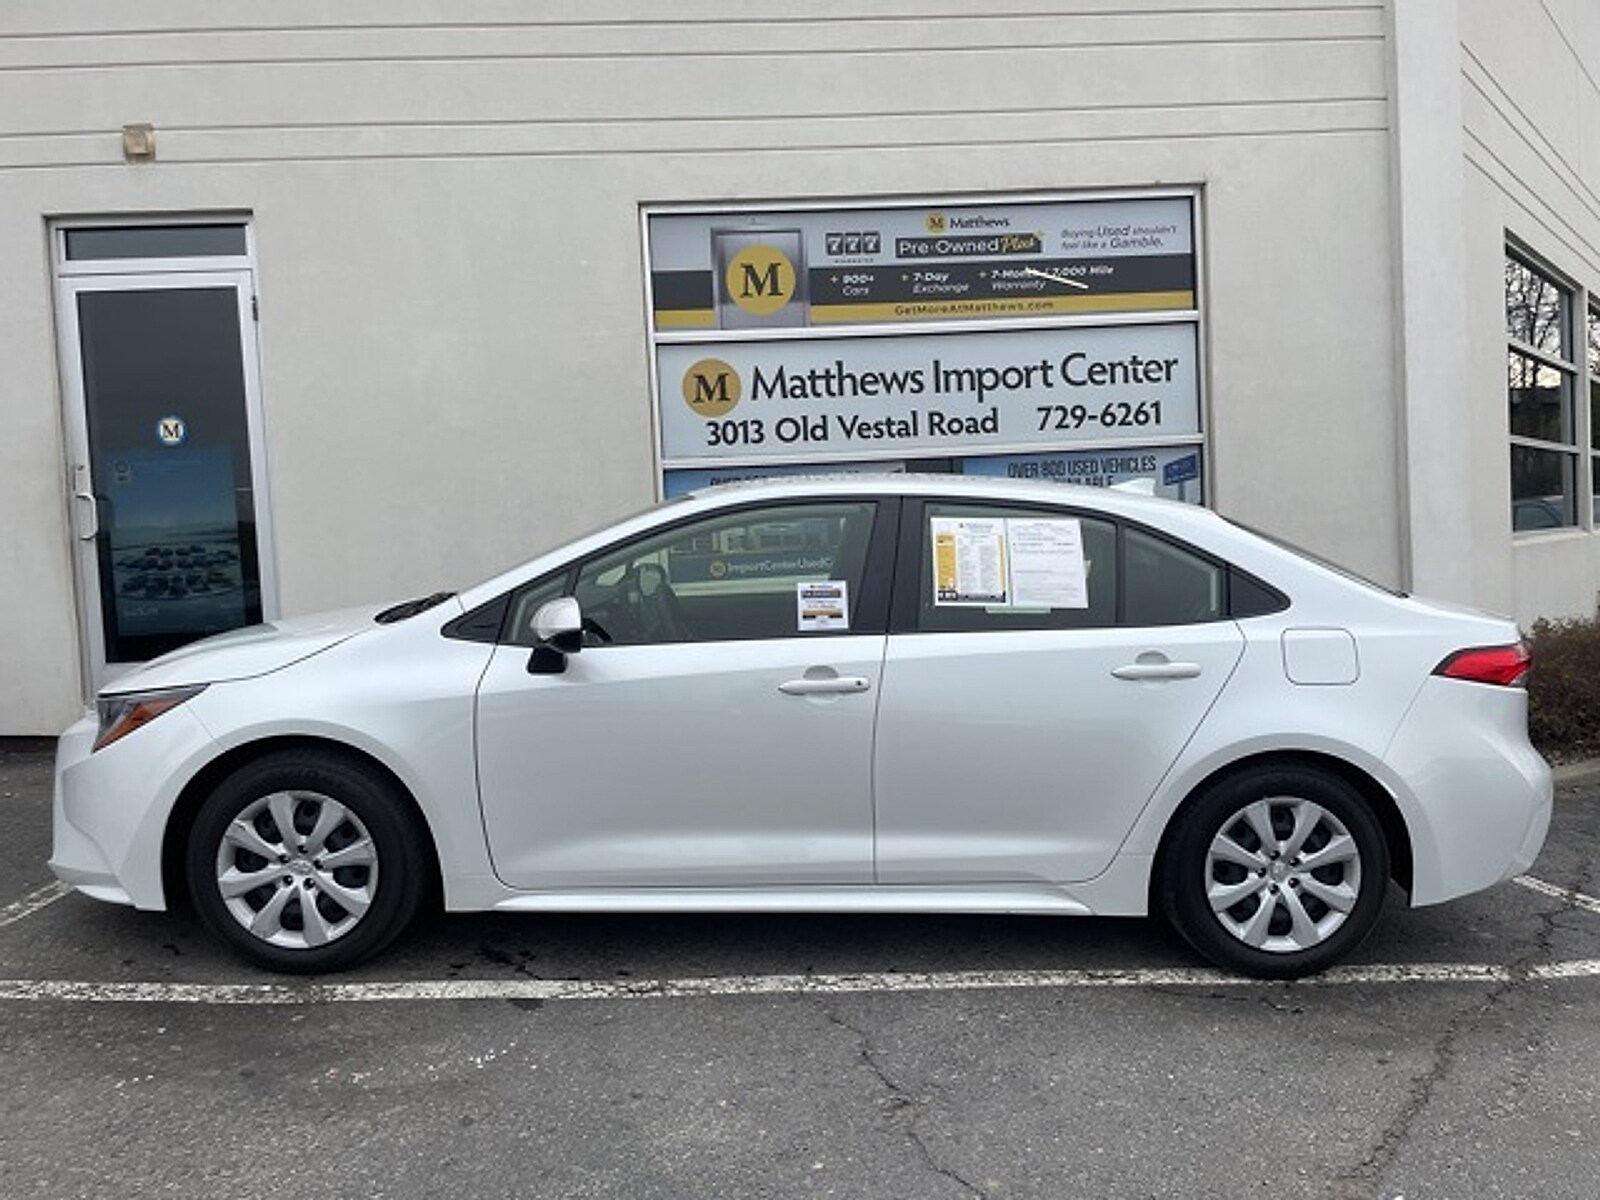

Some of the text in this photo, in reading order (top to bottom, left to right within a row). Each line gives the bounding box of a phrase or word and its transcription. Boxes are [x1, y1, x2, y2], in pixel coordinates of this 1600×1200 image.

[949, 215, 1010, 229] Matthews
[1097, 225, 1131, 237] Used
[1082, 240, 1099, 249] like
[740, 262, 785, 298] M
[912, 271, 950, 283] 7-Day
[842, 284, 869, 296] Cars
[912, 281, 969, 295] Exchange
[692, 352, 1179, 404] M Matthews Import Center
[1036, 400, 1162, 431] 729-6261
[162, 423, 180, 439] M
[706, 406, 999, 446] 3013 Old Vestal Road
[1007, 462, 1038, 479] OVER
[1067, 458, 1099, 476] USED
[1100, 455, 1157, 474] VEHICLES
